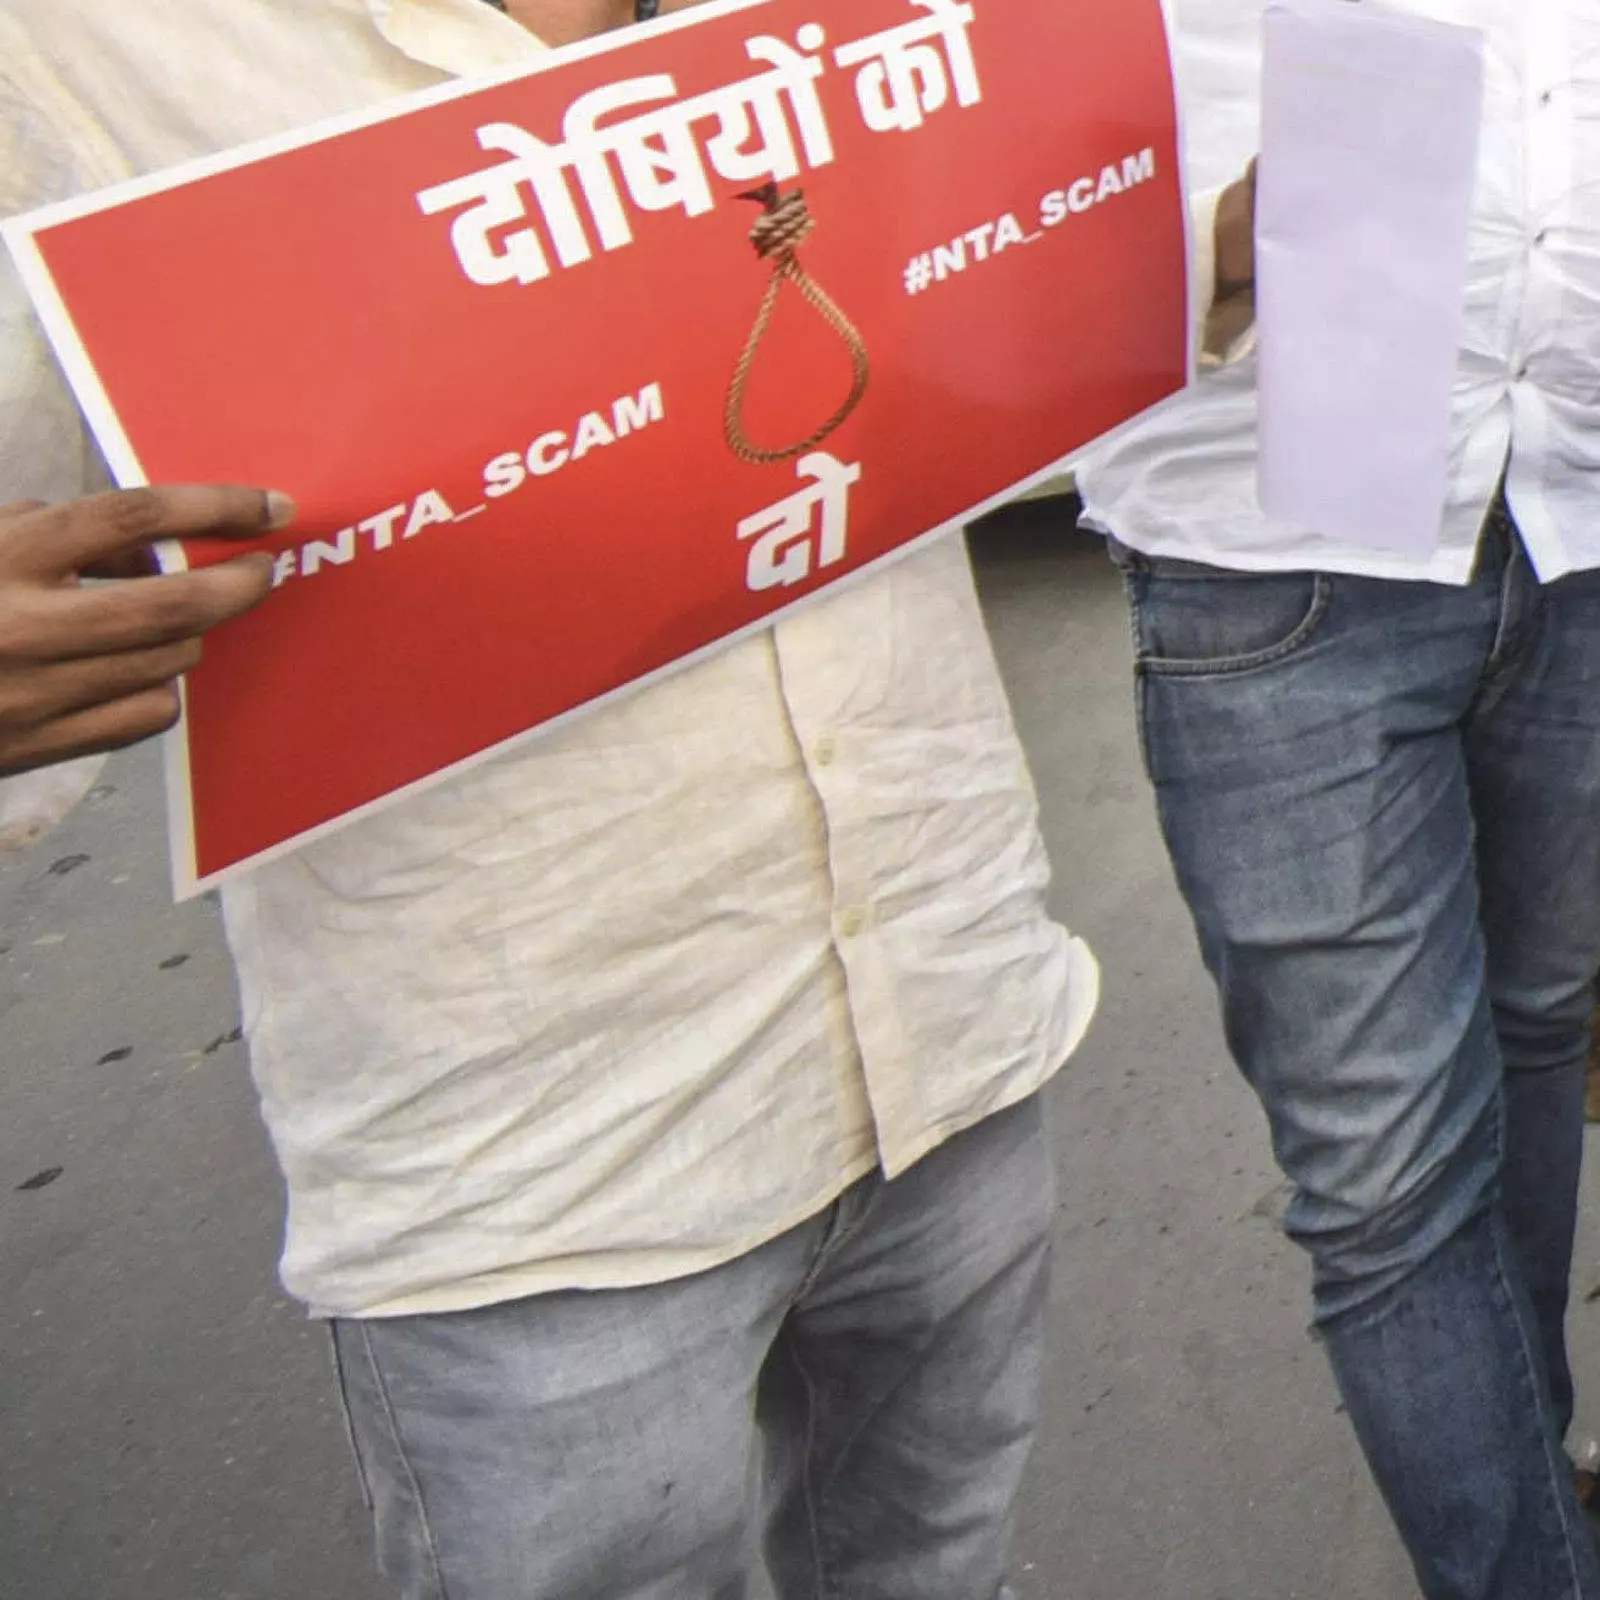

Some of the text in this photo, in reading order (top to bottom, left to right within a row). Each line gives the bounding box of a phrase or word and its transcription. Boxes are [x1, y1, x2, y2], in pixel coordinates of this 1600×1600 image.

[416, 23, 835, 286] दोषियों
[903, 148, 1154, 296] #NTA_SCAM
[737, 451, 861, 590] दो
